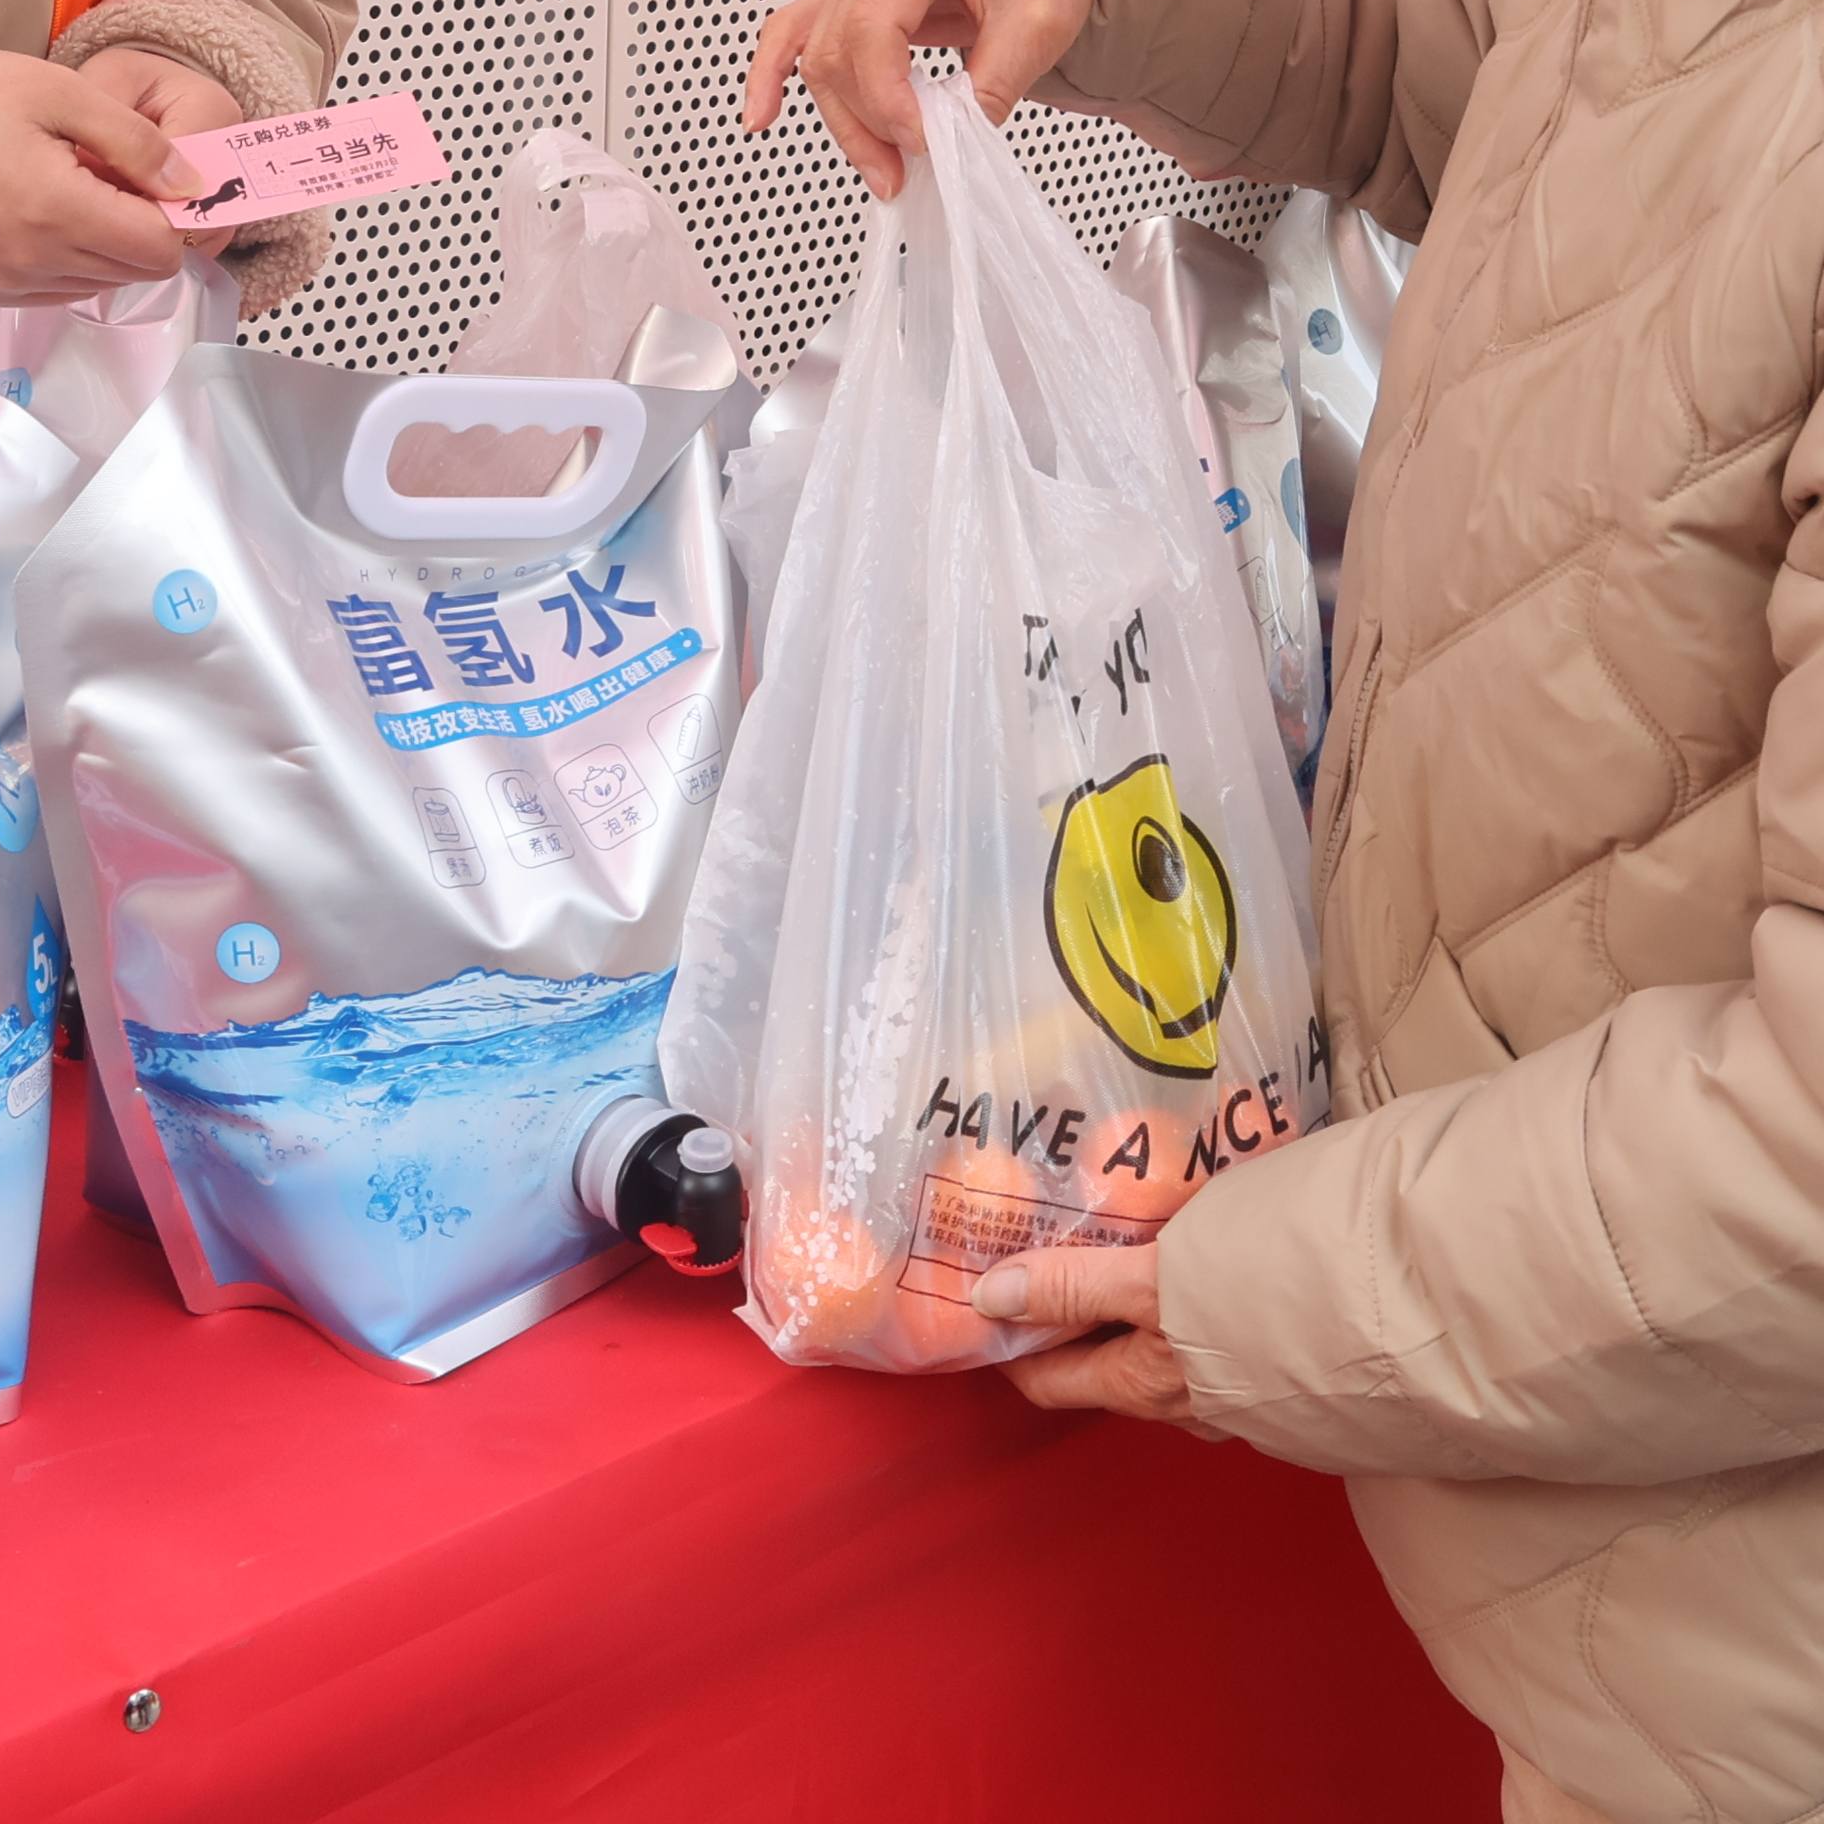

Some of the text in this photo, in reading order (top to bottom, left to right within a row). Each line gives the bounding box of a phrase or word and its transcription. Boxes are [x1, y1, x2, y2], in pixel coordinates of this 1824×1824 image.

[326, 565, 656, 697] 富氢水
[518, 647, 677, 731] 氢水喝出健康
[603, 805, 643, 838] 泡茶
[916, 1077, 1086, 1167] HAVE
[1102, 1122, 1151, 1180] A
